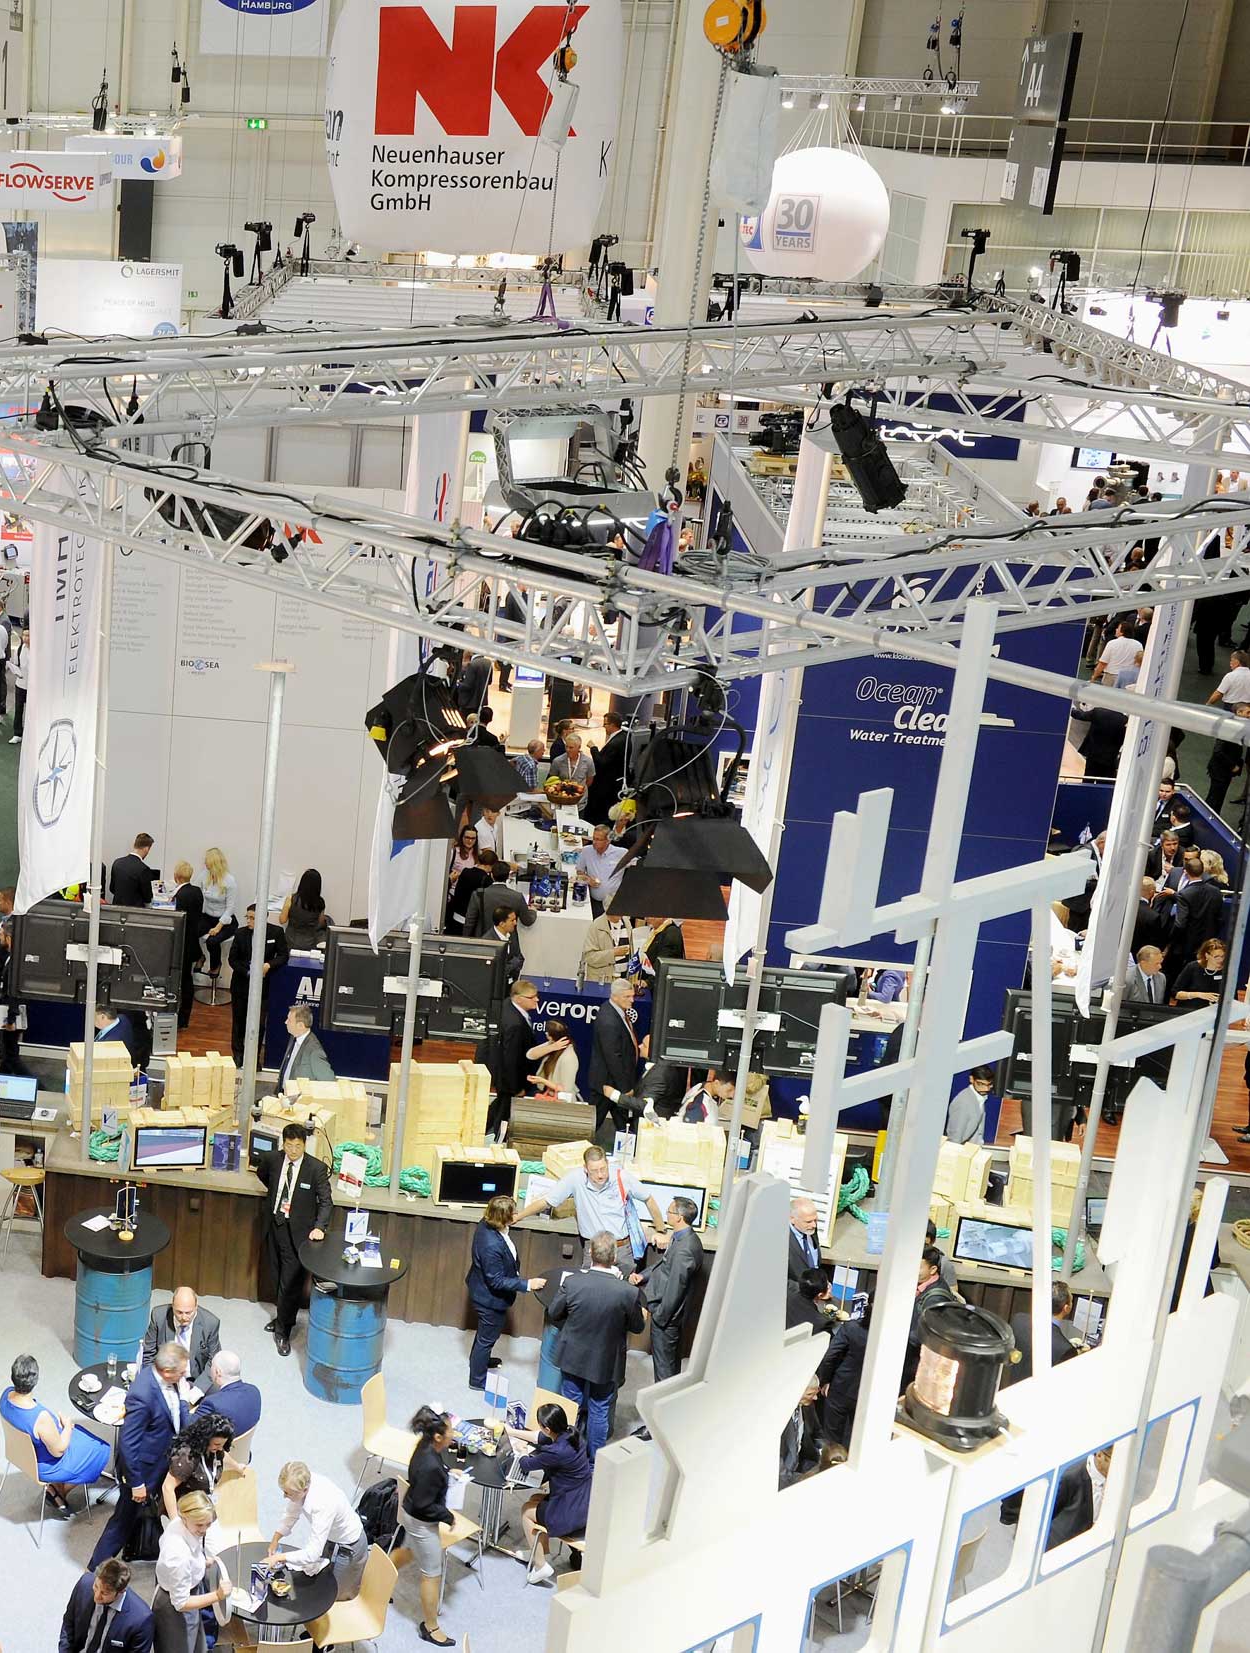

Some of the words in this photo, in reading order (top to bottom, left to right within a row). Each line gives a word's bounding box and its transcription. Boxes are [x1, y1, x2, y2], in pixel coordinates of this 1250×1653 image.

[374, 5, 590, 137] NK
[1024, 62, 1045, 107] A4
[371, 144, 506, 166] Neuenhauser
[370, 168, 554, 192] Kompressorenbau
[370, 193, 432, 212] GmbH
[776, 198, 814, 231] 30
[775, 235, 811, 249] YEARS
[136, 267, 180, 278] LAGERSMIT
[893, 704, 950, 733] Clea
[850, 728, 890, 743] Water
[892, 732, 946, 747] Treatme
